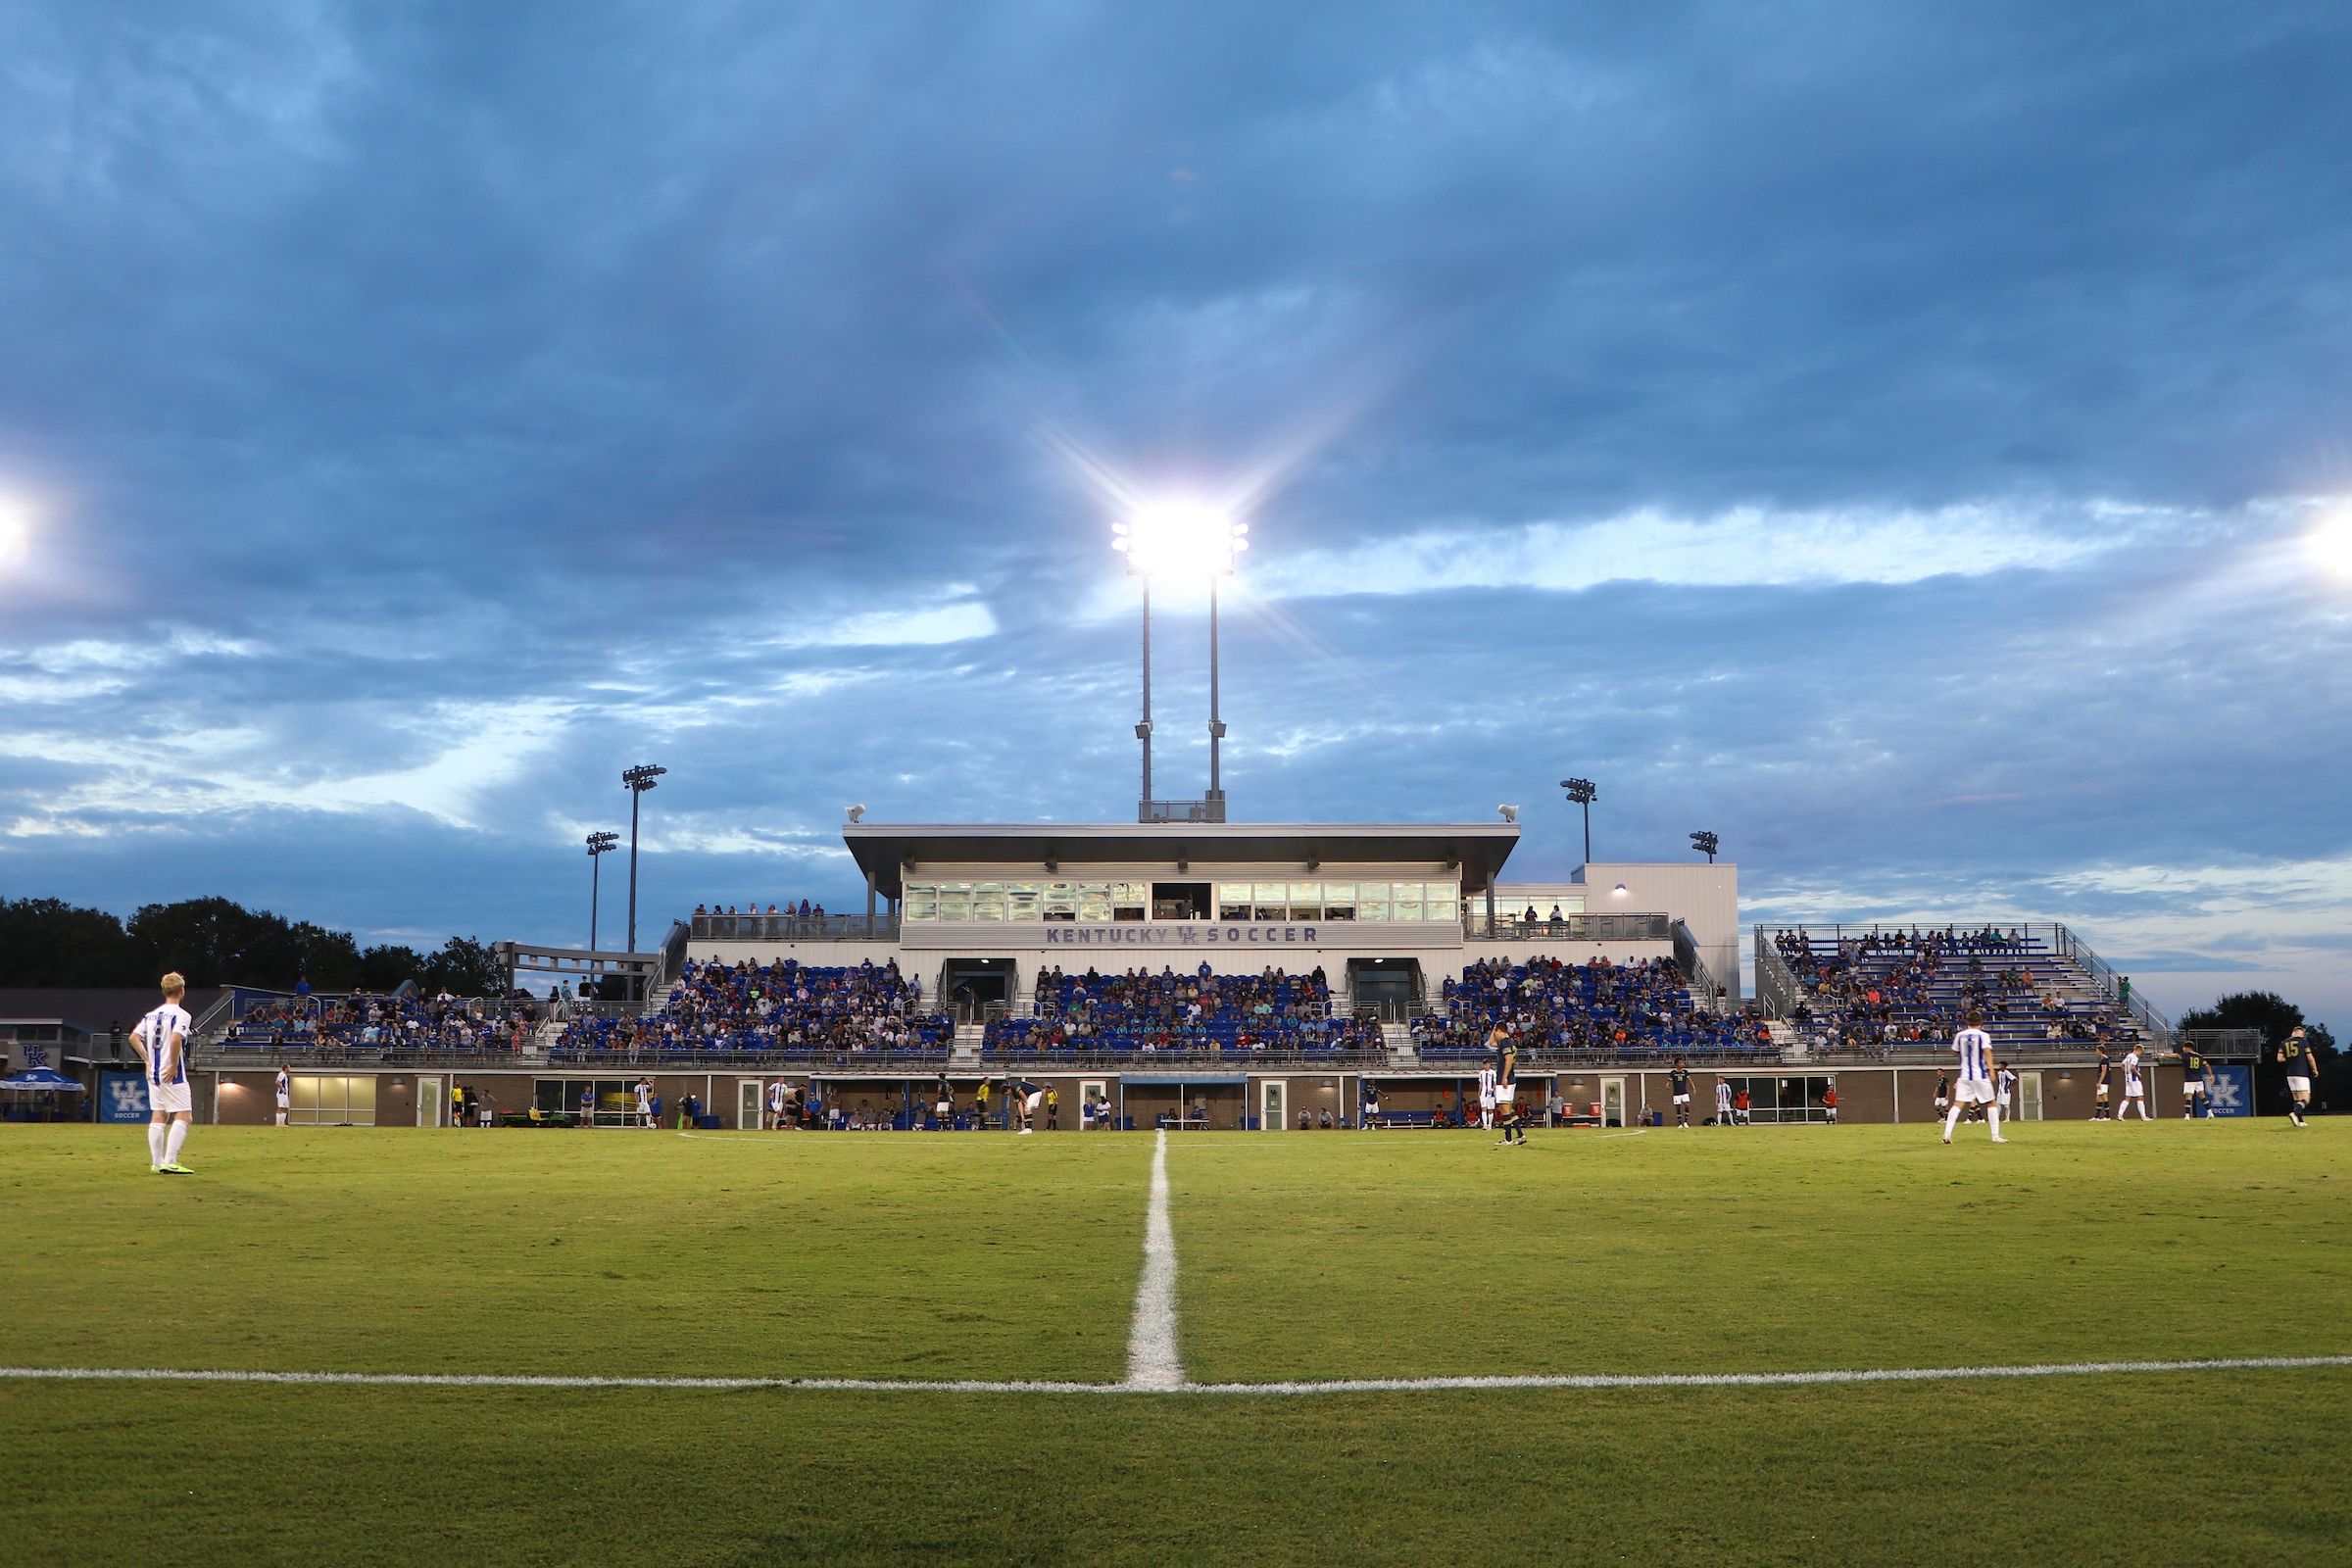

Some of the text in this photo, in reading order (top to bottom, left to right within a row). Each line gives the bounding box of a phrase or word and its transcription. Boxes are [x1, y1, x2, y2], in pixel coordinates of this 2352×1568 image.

[1047, 928, 1167, 943] KENTUCKY
[1207, 927, 1316, 942] SOCCER
[23, 1045, 45, 1066] UK
[2284, 1041, 2299, 1058] 15
[2189, 1056, 2200, 1069] 18
[110, 1080, 147, 1111] UK
[2202, 1074, 2240, 1106] UK
